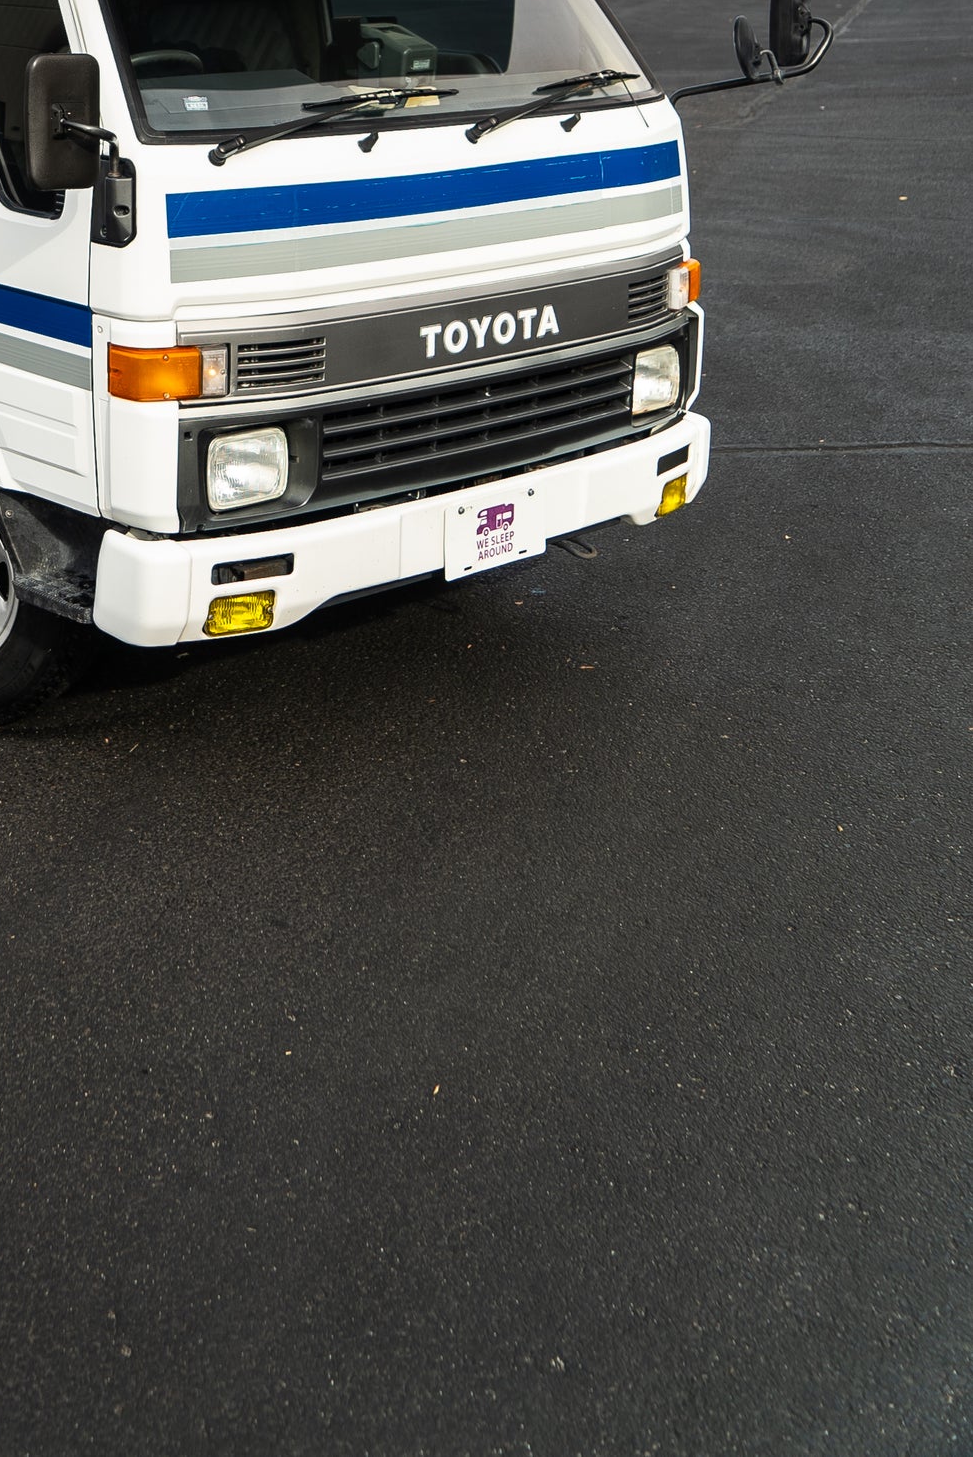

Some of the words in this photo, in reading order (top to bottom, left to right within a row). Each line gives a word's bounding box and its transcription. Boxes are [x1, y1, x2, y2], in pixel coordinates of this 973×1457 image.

[420, 304, 560, 359] TOYOTA
[476, 538, 489, 550] WE
[491, 530, 515, 546] SLEEP
[477, 542, 514, 561] AROUND
